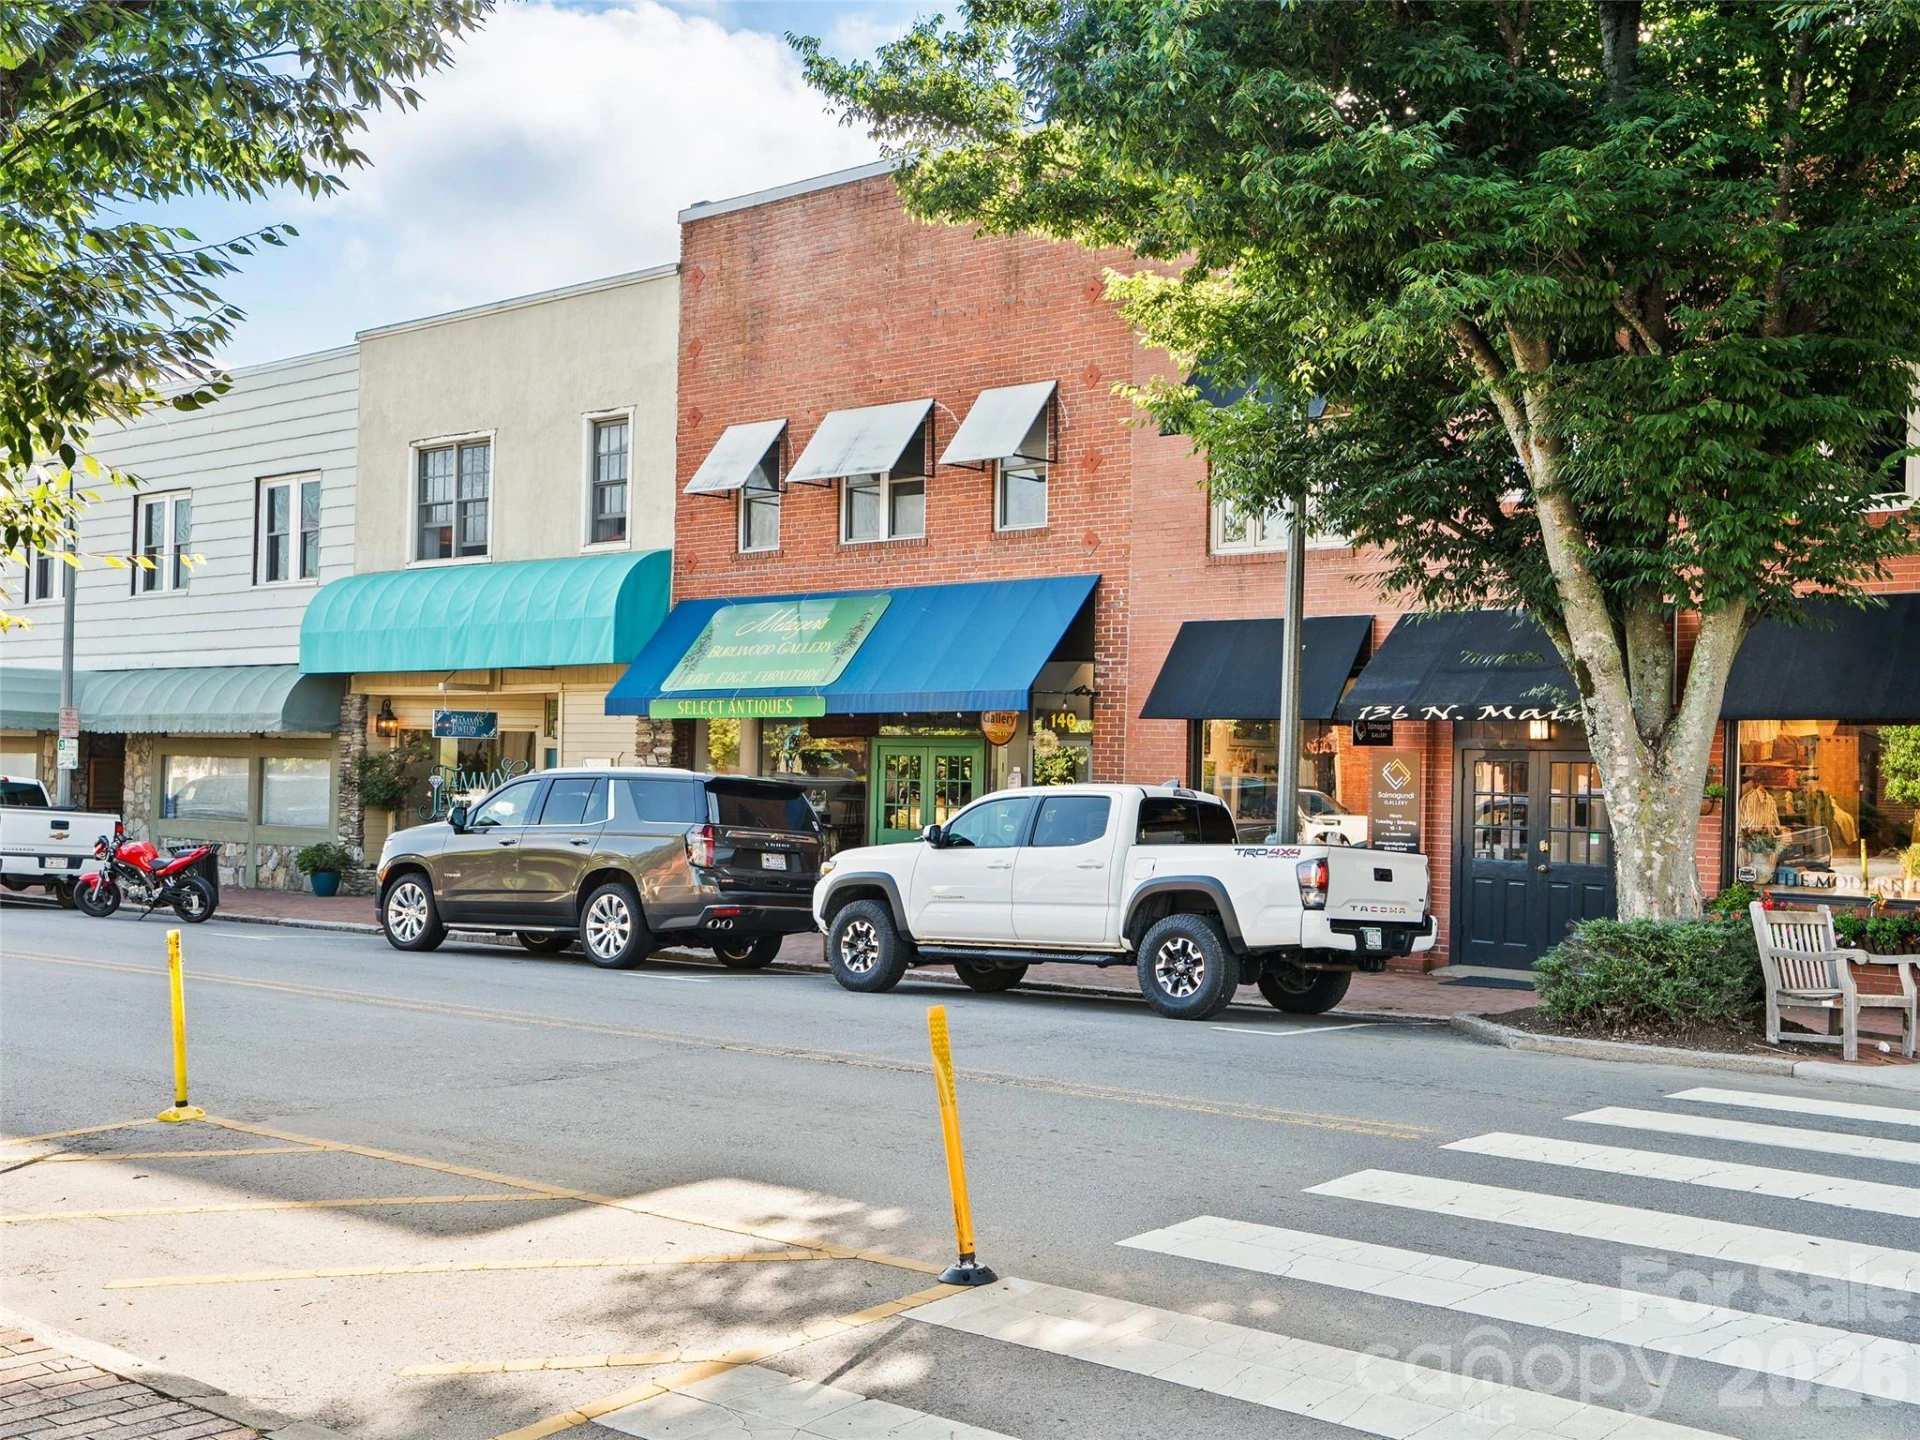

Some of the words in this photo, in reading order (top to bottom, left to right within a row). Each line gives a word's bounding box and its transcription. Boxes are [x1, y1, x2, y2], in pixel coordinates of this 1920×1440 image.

[708, 644, 776, 658] BURLWOOD
[777, 640, 837, 655] GALLERY
[684, 672, 714, 685] LIVE
[716, 671, 752, 684] EDGE
[753, 669, 824, 682] FURNITURE
[677, 700, 725, 715] SELECT
[727, 698, 793, 715] ANTIQUES
[1358, 705, 1409, 720] 136
[1420, 704, 1464, 720] N.
[983, 711, 1016, 727] Gallery
[1051, 713, 1077, 728] 140
[1350, 905, 1406, 914] TACOMA
